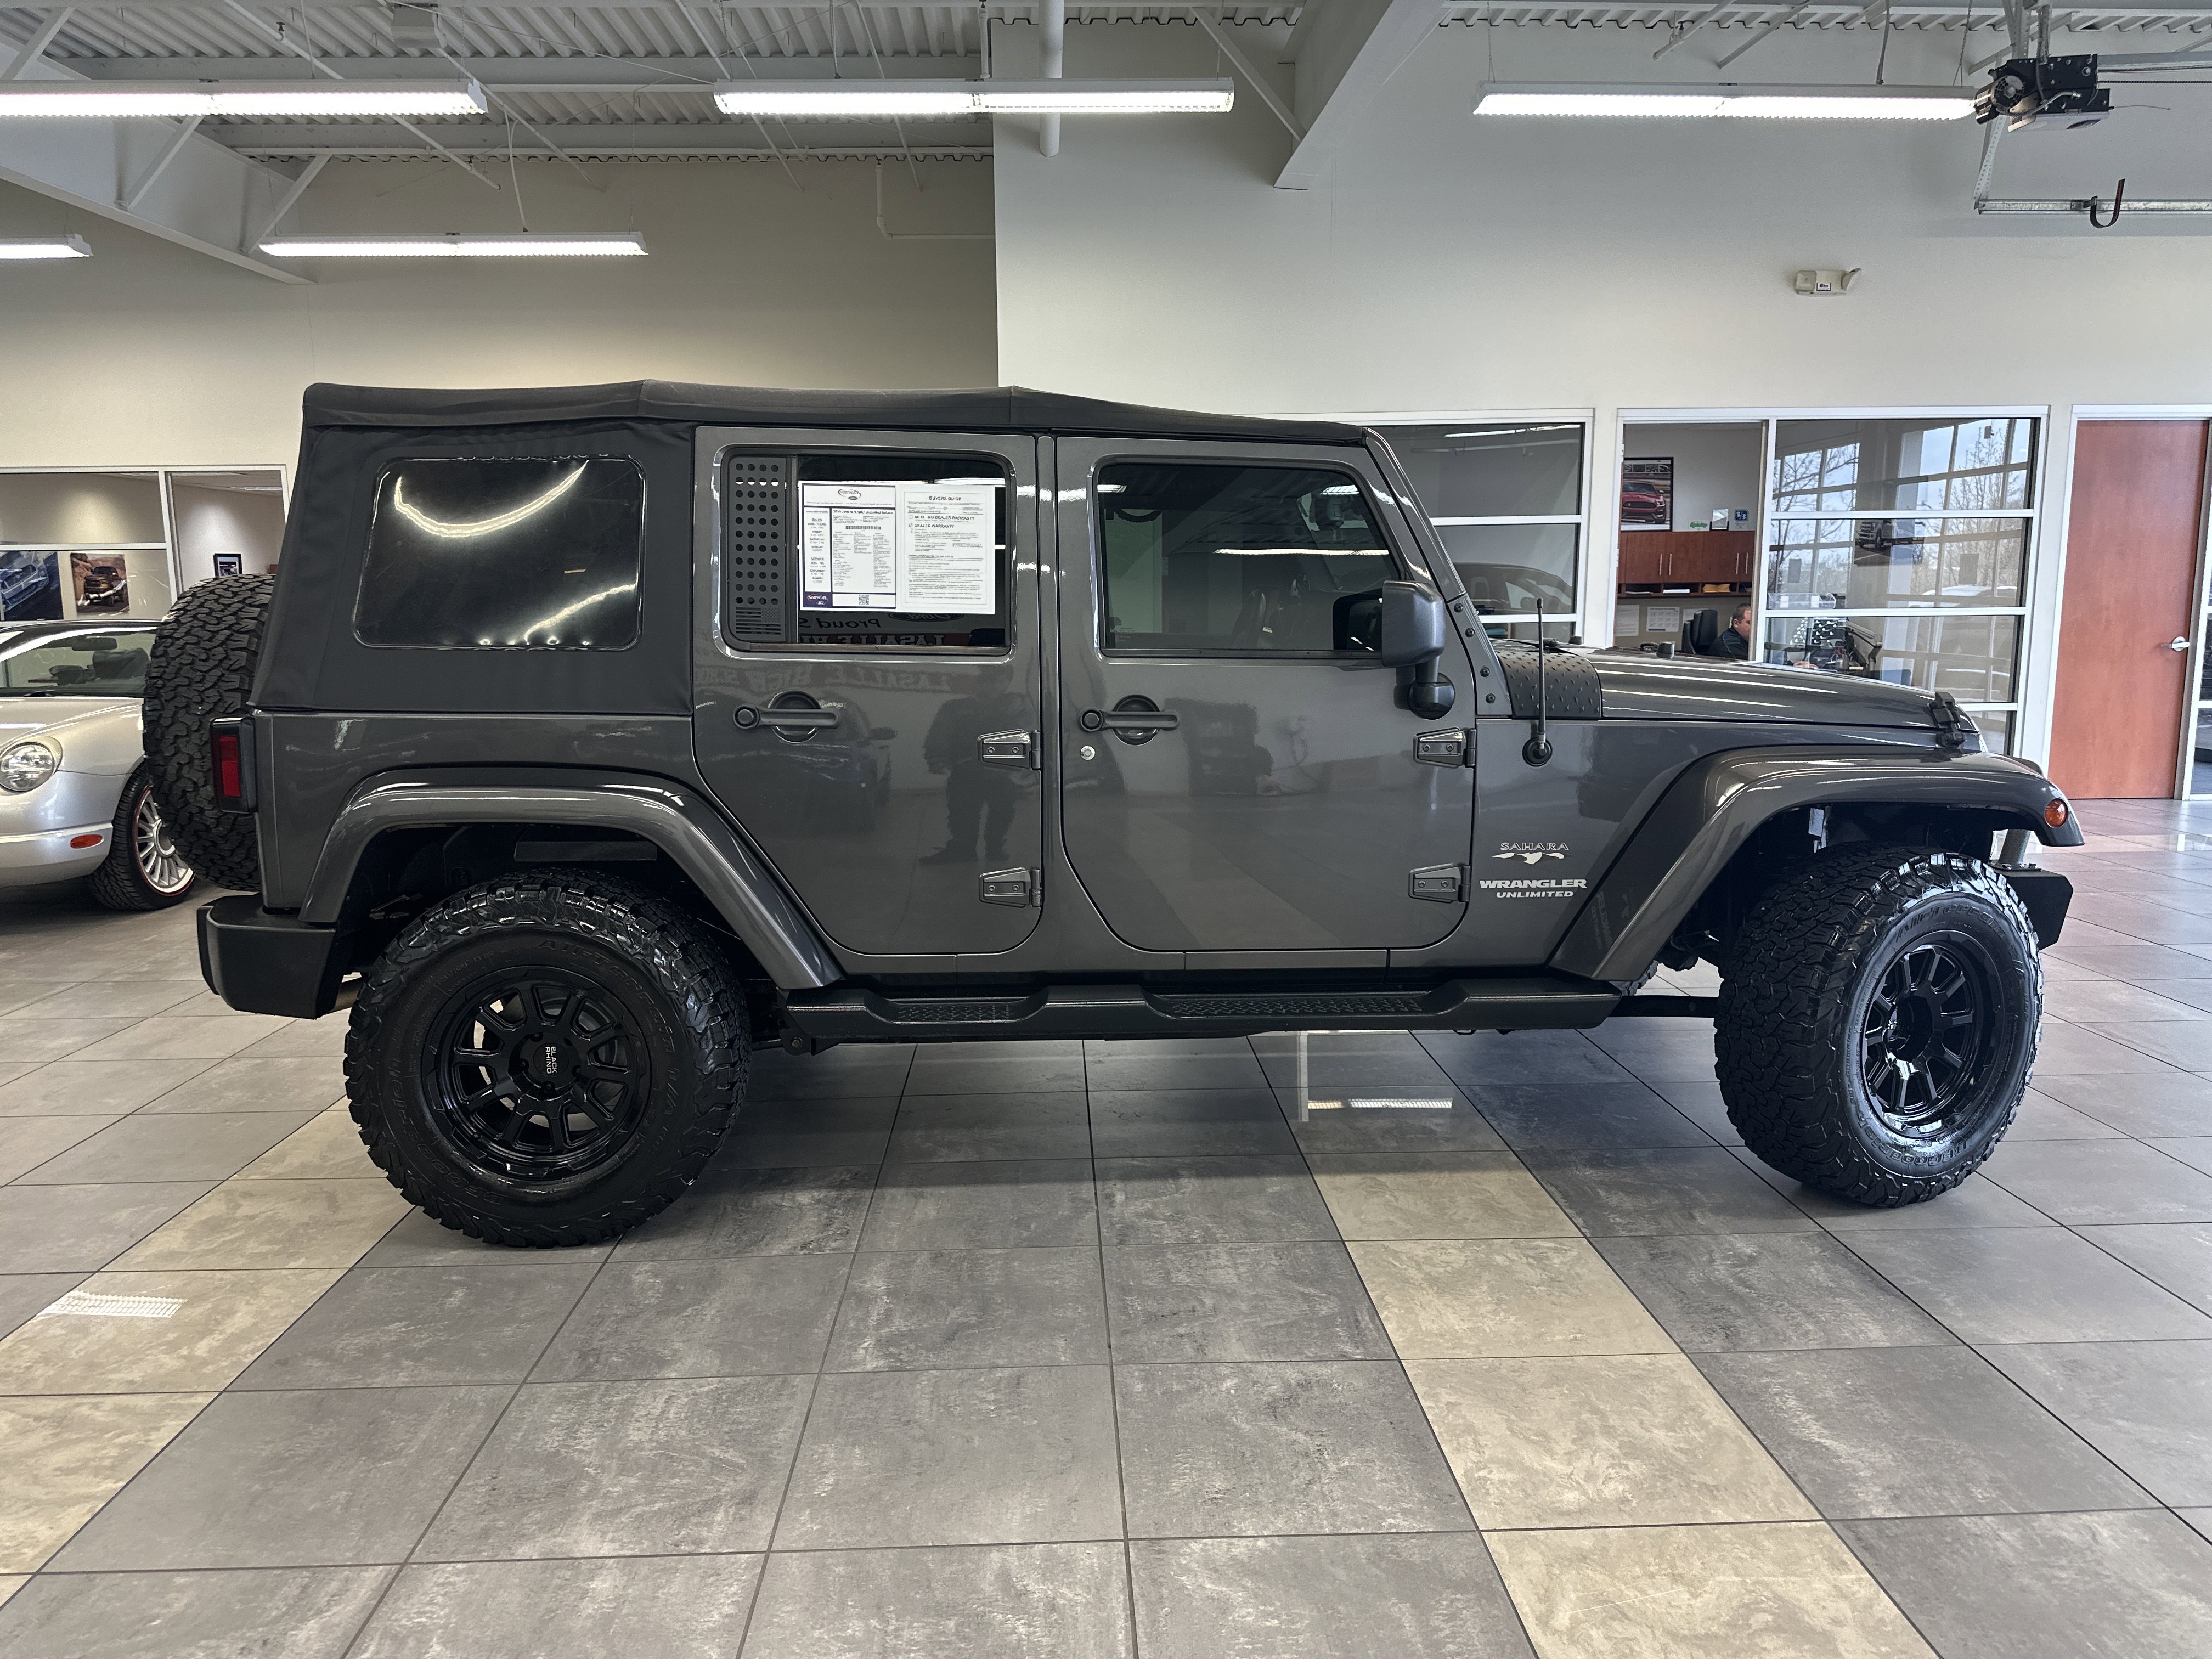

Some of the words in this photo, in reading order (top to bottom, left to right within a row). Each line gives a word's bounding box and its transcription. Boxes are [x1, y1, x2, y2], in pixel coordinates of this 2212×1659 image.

[1500, 842, 1569, 850] SAHARA
[1480, 879, 1587, 889] WRANGLER
[536, 940, 675, 1053] All-Terrain
[1857, 1109, 1967, 1166] BFGoodrich
